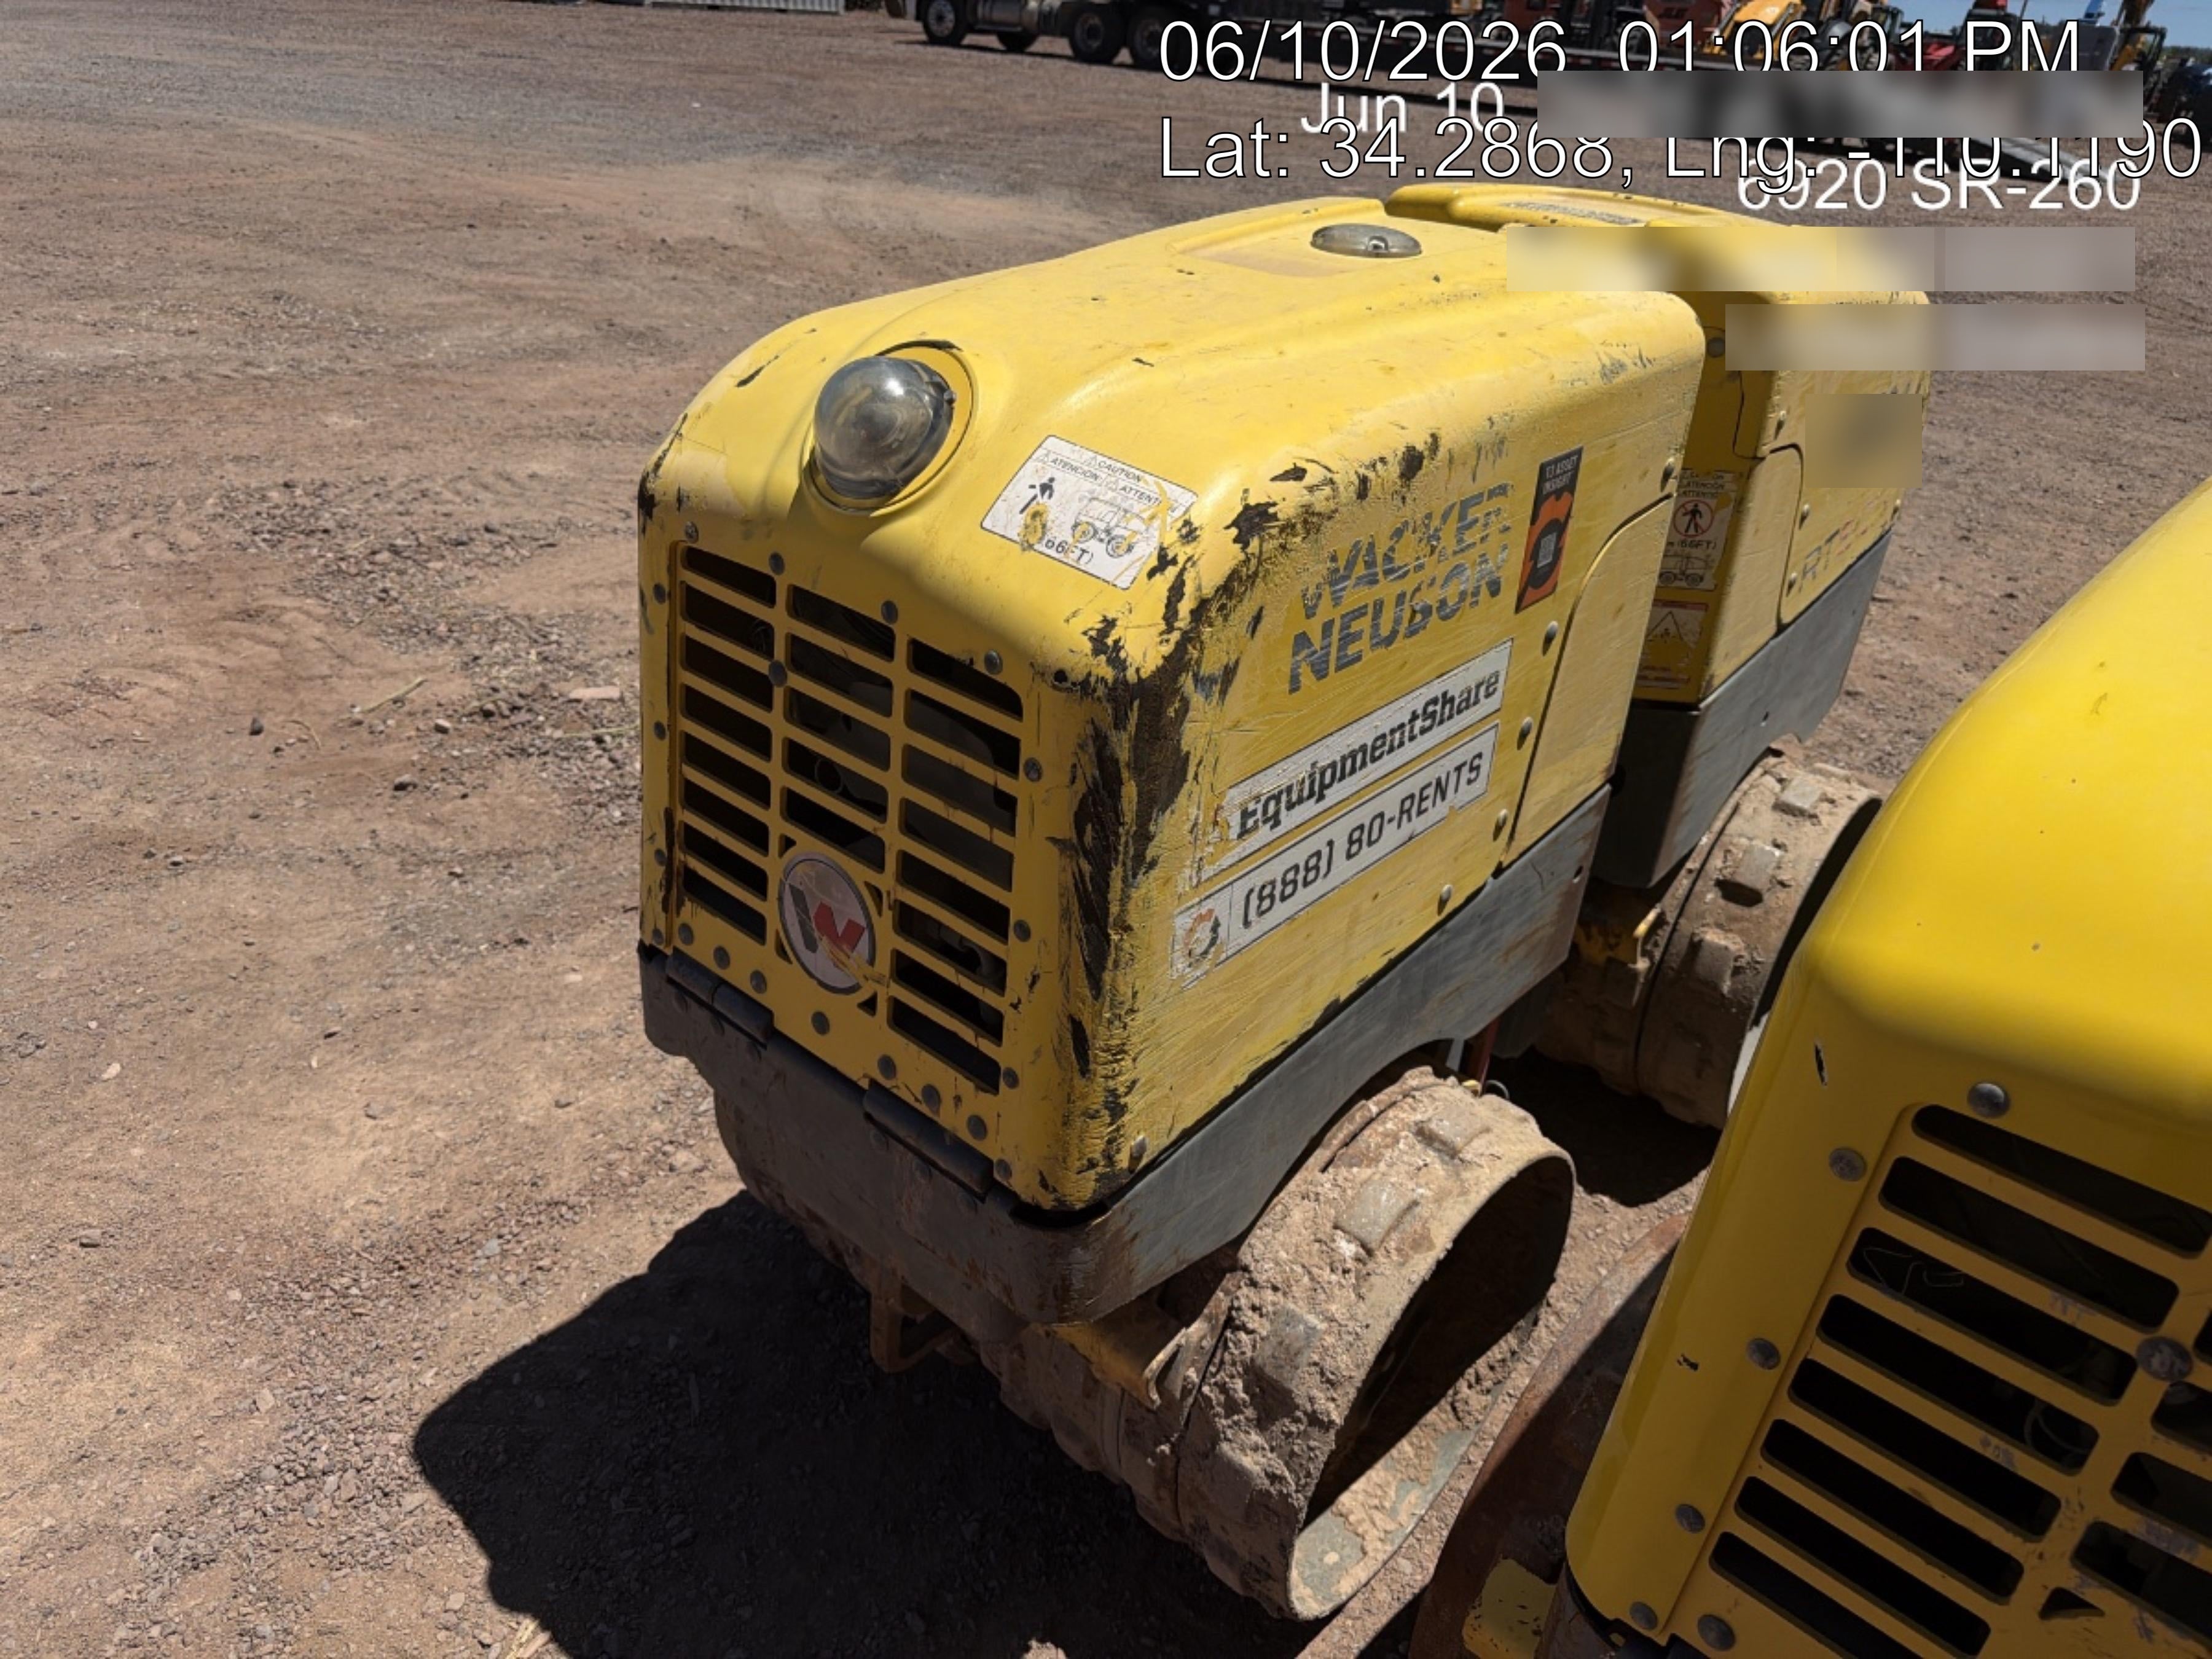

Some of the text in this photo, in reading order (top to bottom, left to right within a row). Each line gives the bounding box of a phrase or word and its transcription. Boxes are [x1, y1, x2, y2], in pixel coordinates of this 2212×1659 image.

[1098, 460, 1142, 482] CAUTION
[1288, 542, 1509, 695] NEUSON
[1236, 670, 1501, 840] EquipmentShare
[1242, 751, 1484, 929] (888) 80-RENTS
